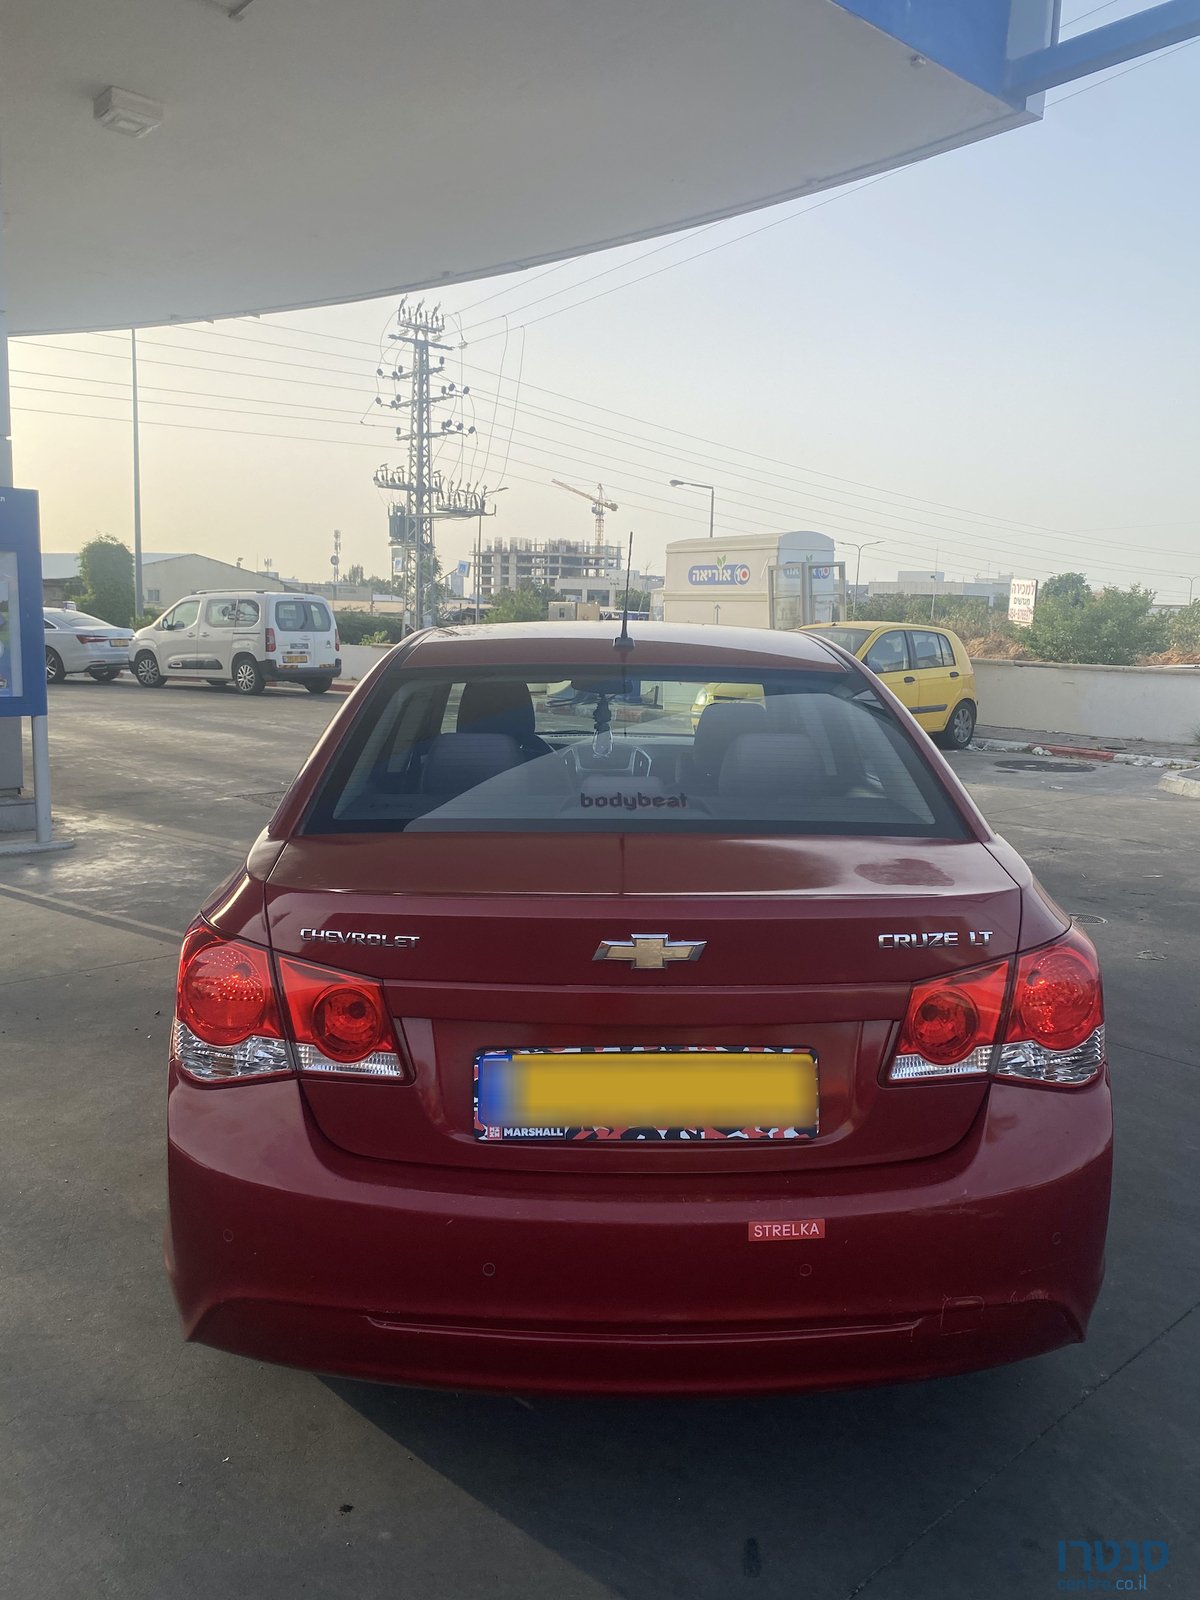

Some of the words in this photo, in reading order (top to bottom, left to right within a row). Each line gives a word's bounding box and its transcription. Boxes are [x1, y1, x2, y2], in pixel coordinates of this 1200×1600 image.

[692, 569, 731, 582] אוריאה
[1011, 581, 1035, 596] למכירה
[580, 792, 688, 810] bodybeat
[300, 928, 420, 948] CHEVROLET
[878, 931, 959, 949] CRUZE
[969, 931, 993, 946] LT
[503, 1127, 564, 1137] MARSHALL
[754, 1222, 820, 1238] STRELKA
